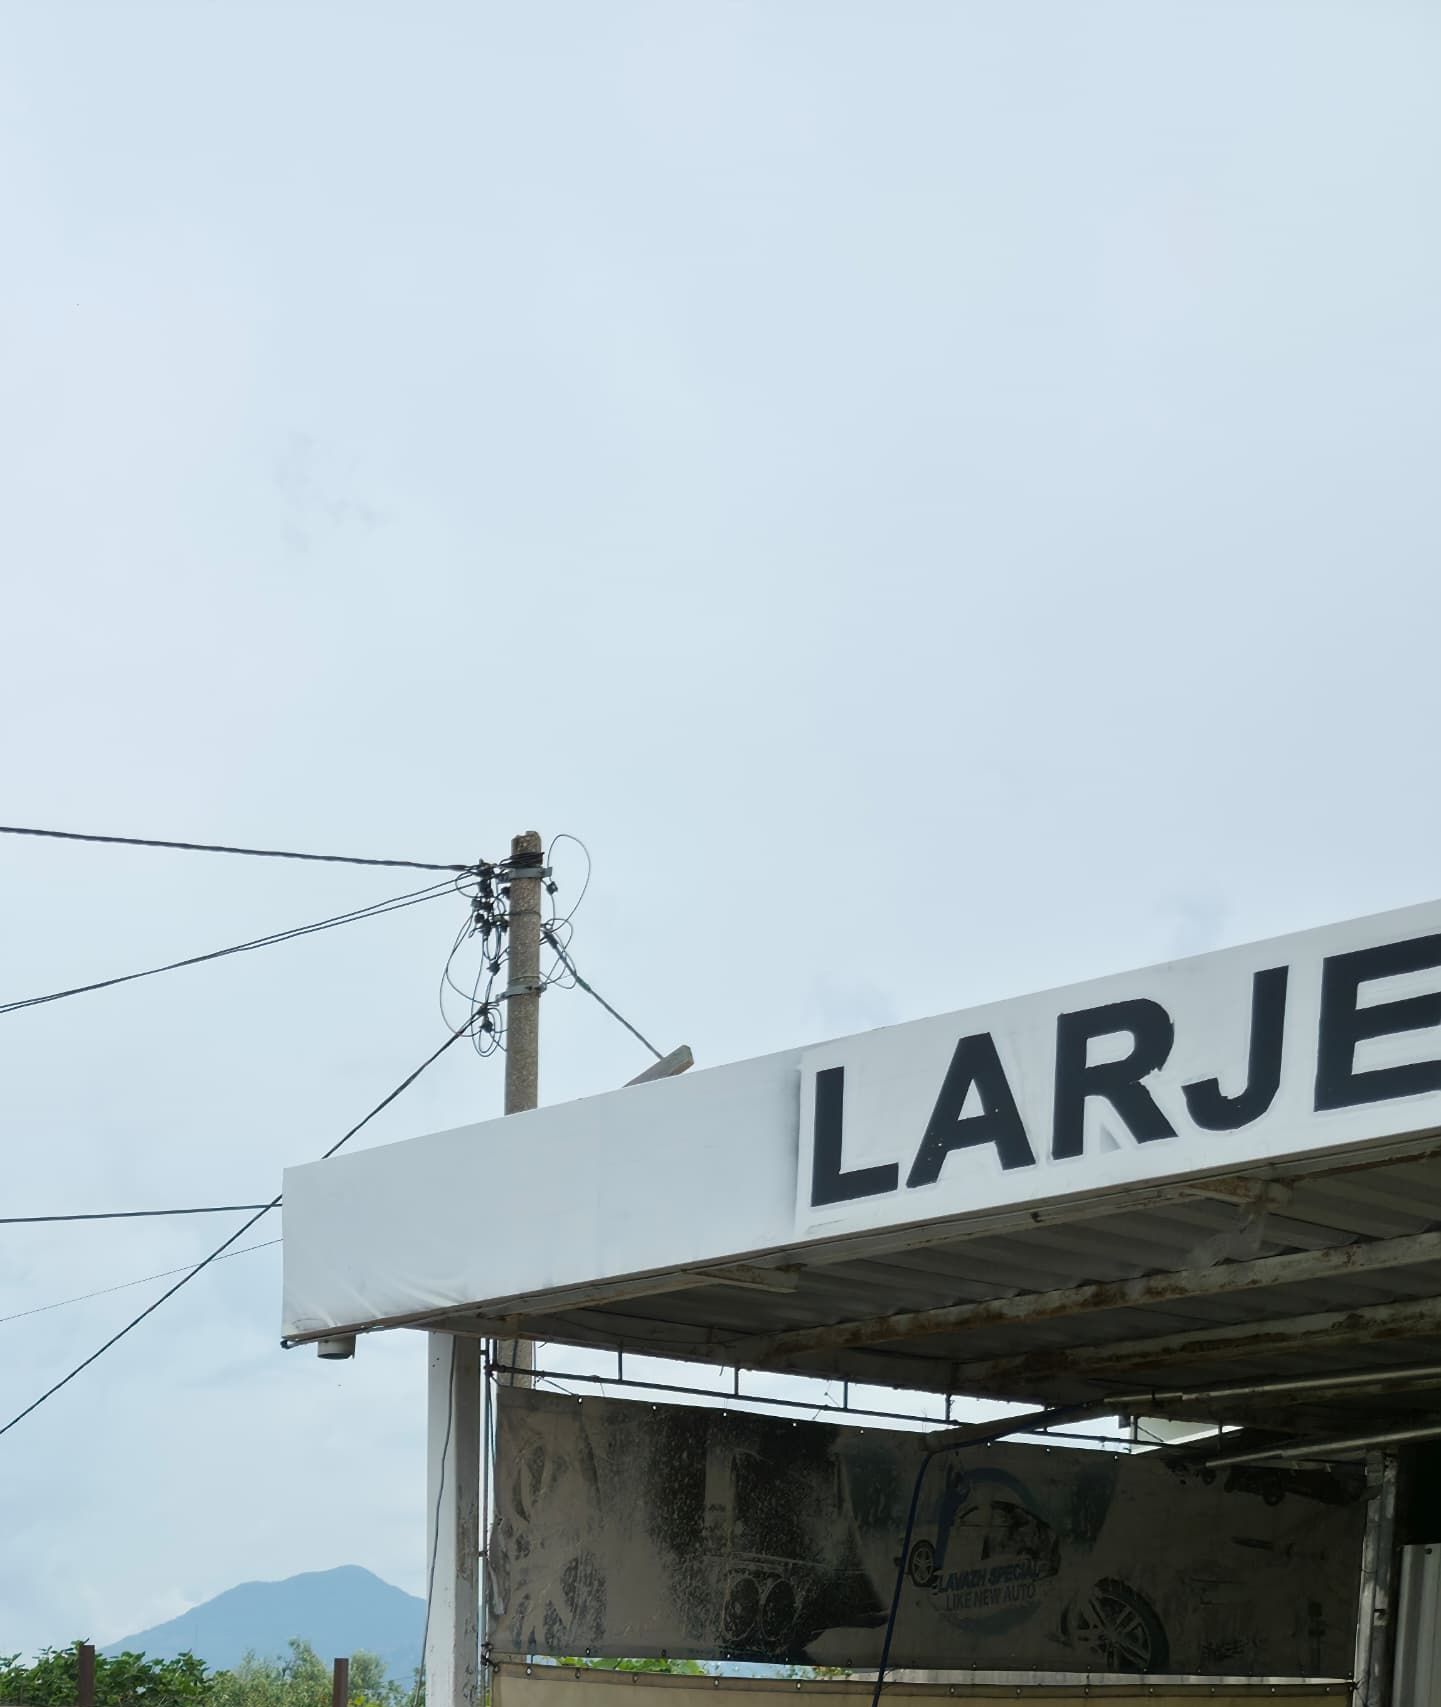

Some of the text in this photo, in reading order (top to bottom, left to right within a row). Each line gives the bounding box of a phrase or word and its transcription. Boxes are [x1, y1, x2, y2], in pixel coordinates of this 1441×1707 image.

[810, 933, 1441, 1206] LARJE
[945, 1583, 1036, 1610] LIKE NEW AUTO
